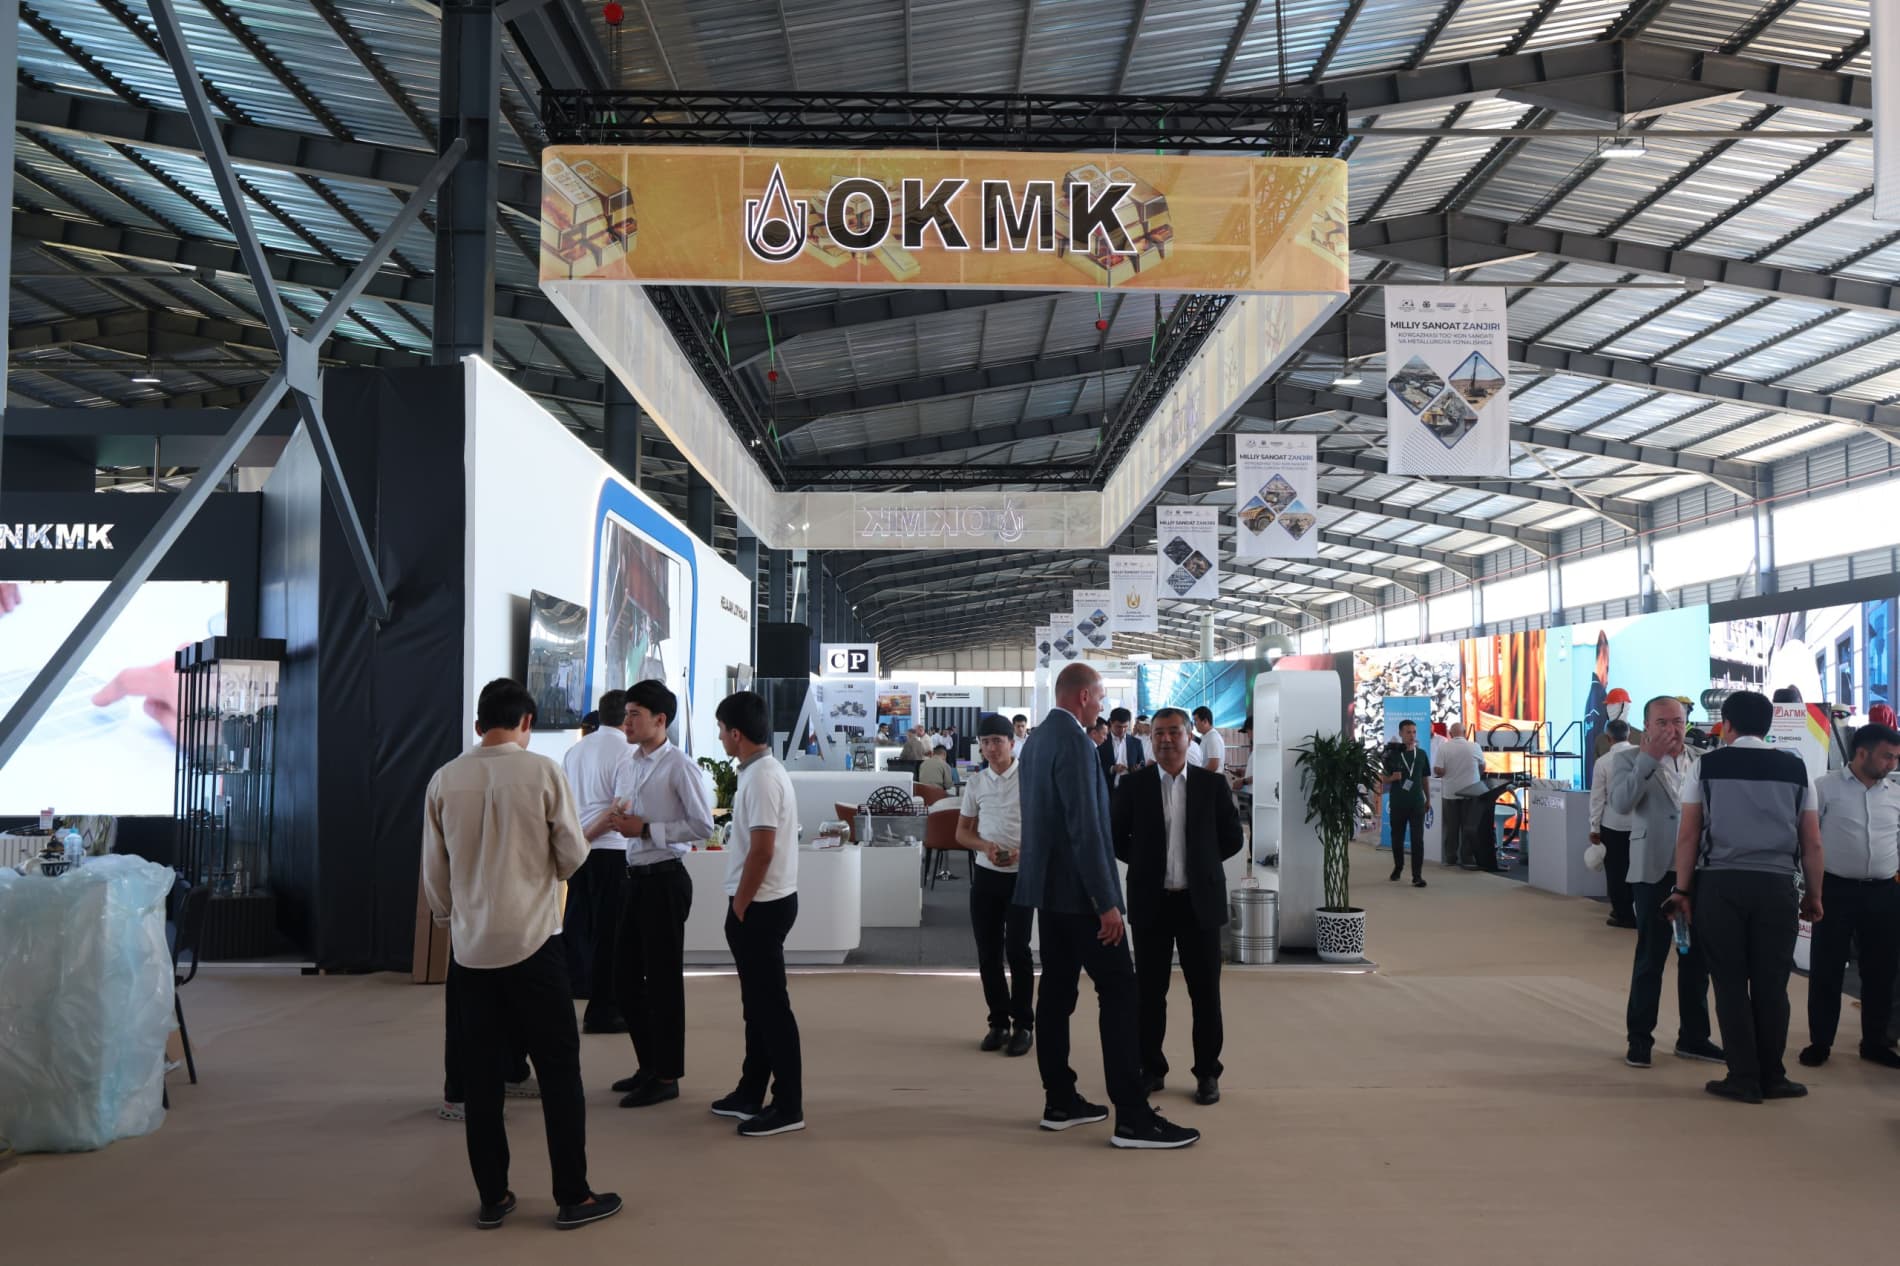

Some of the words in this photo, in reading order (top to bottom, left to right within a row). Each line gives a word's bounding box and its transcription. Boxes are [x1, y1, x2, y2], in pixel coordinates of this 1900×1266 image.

[824, 177, 1138, 254] OKMK
[1390, 321, 1420, 329] MILLIY
[1422, 322, 1461, 330] SANOAT
[1462, 322, 1500, 331] ZANJIRI
[0, 523, 115, 550] NKMK
[831, 652, 866, 669] CP
[1784, 709, 1806, 718] АГМК
